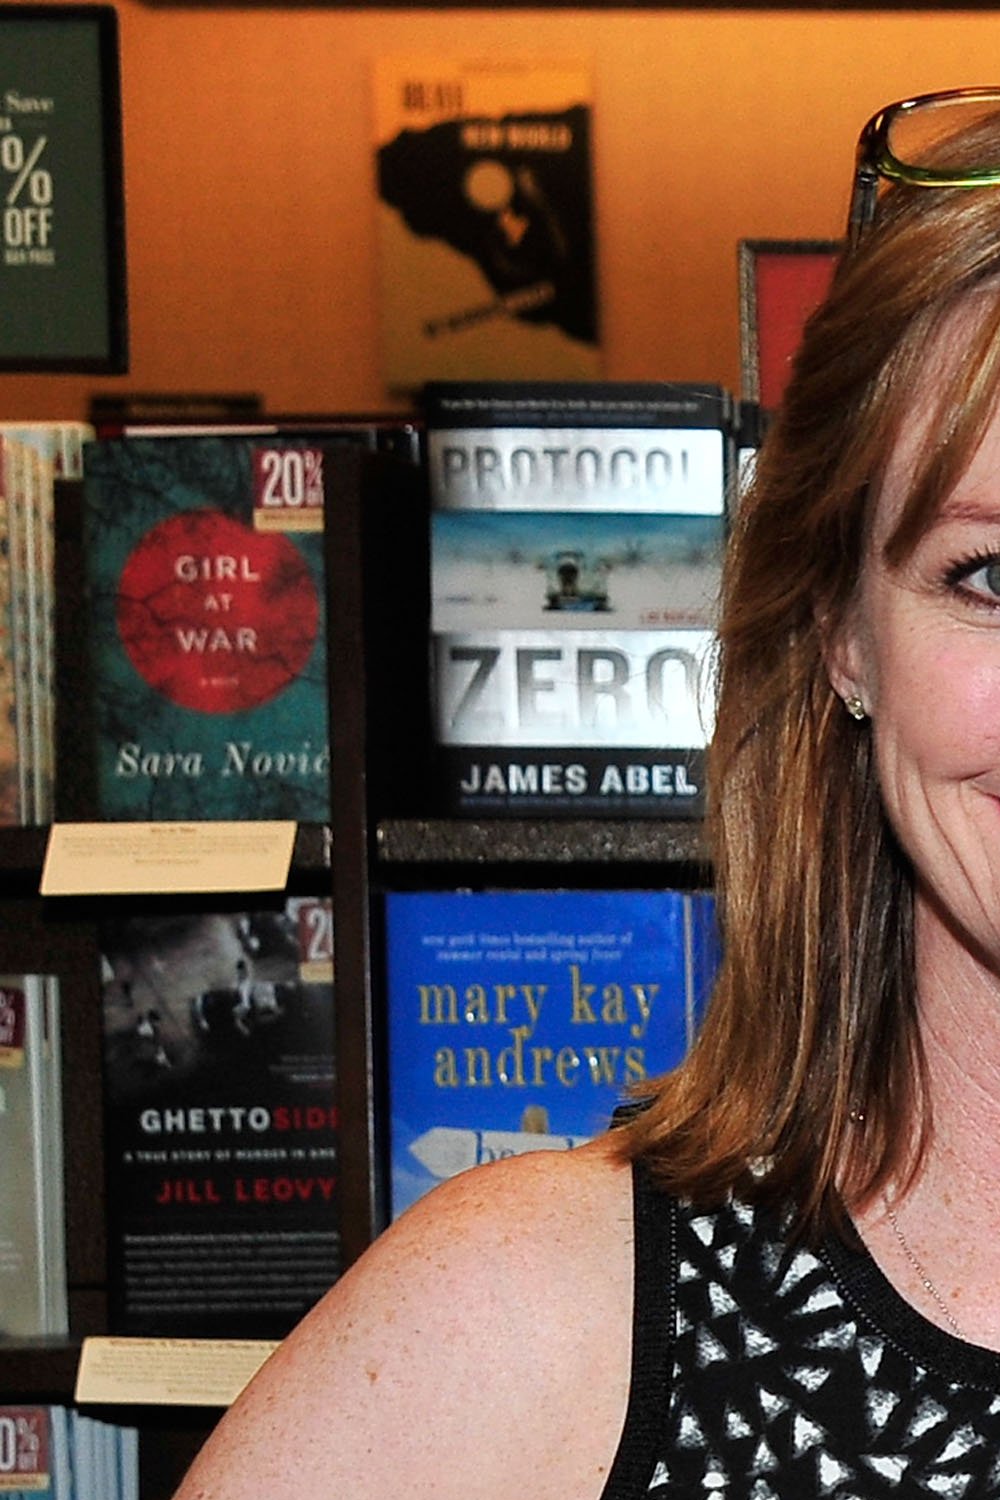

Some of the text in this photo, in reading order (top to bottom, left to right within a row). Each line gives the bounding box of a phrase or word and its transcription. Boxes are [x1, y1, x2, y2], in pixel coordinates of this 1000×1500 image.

[4, 207, 53, 247] OFF
[173, 554, 260, 584] GIRL
[203, 593, 233, 612] AT
[175, 626, 258, 655] WAR
[450, 645, 700, 730] ZERO
[115, 742, 203, 778] Sara
[460, 764, 698, 797] JAMES ABEL
[307, 907, 334, 959] 2
[416, 963, 661, 1038] mary kay
[433, 1025, 649, 1088] andrews
[156, 1176, 337, 1204] JILL LEOVY
